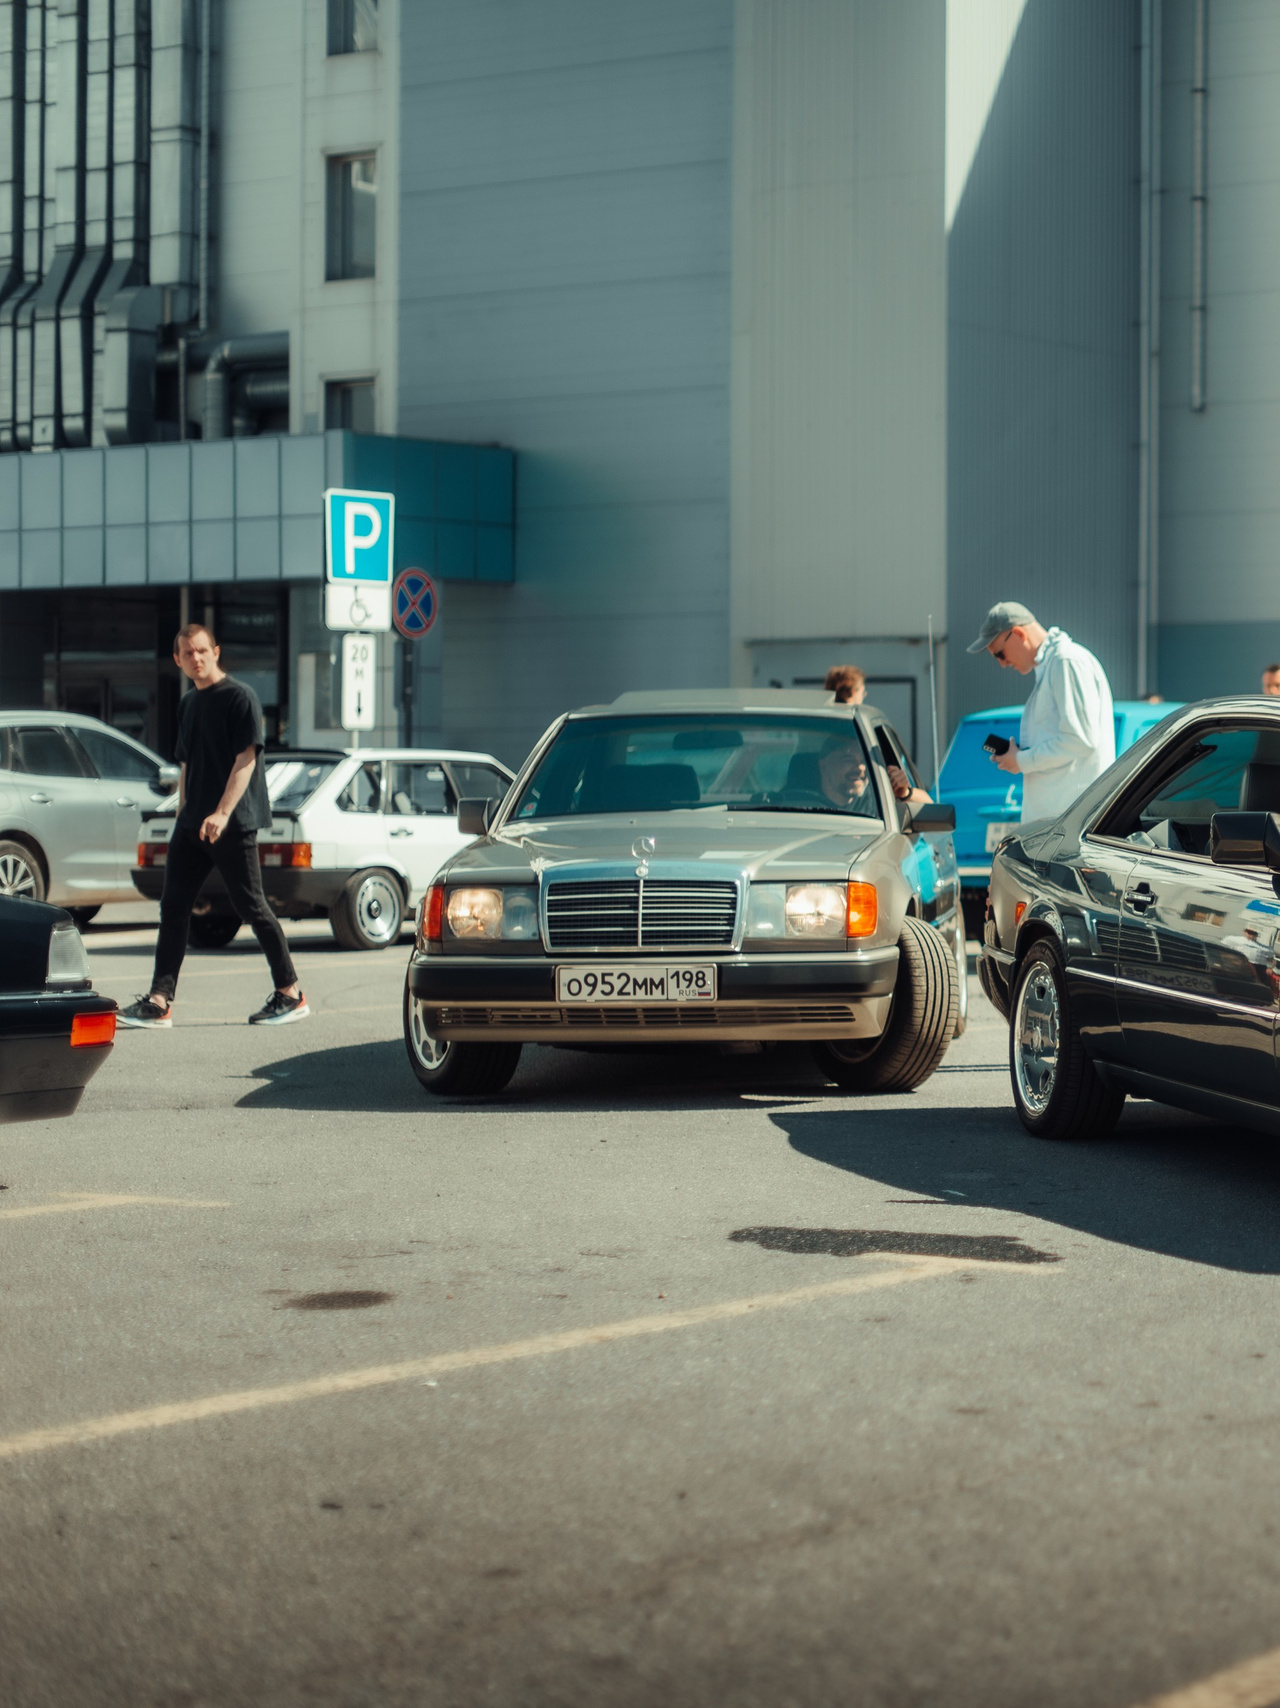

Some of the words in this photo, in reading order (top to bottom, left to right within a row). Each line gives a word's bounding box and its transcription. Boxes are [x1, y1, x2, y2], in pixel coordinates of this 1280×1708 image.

[344, 501, 382, 574] P
[351, 644, 368, 662] 20
[670, 970, 706, 989] 198
[679, 989, 697, 997] RUS
